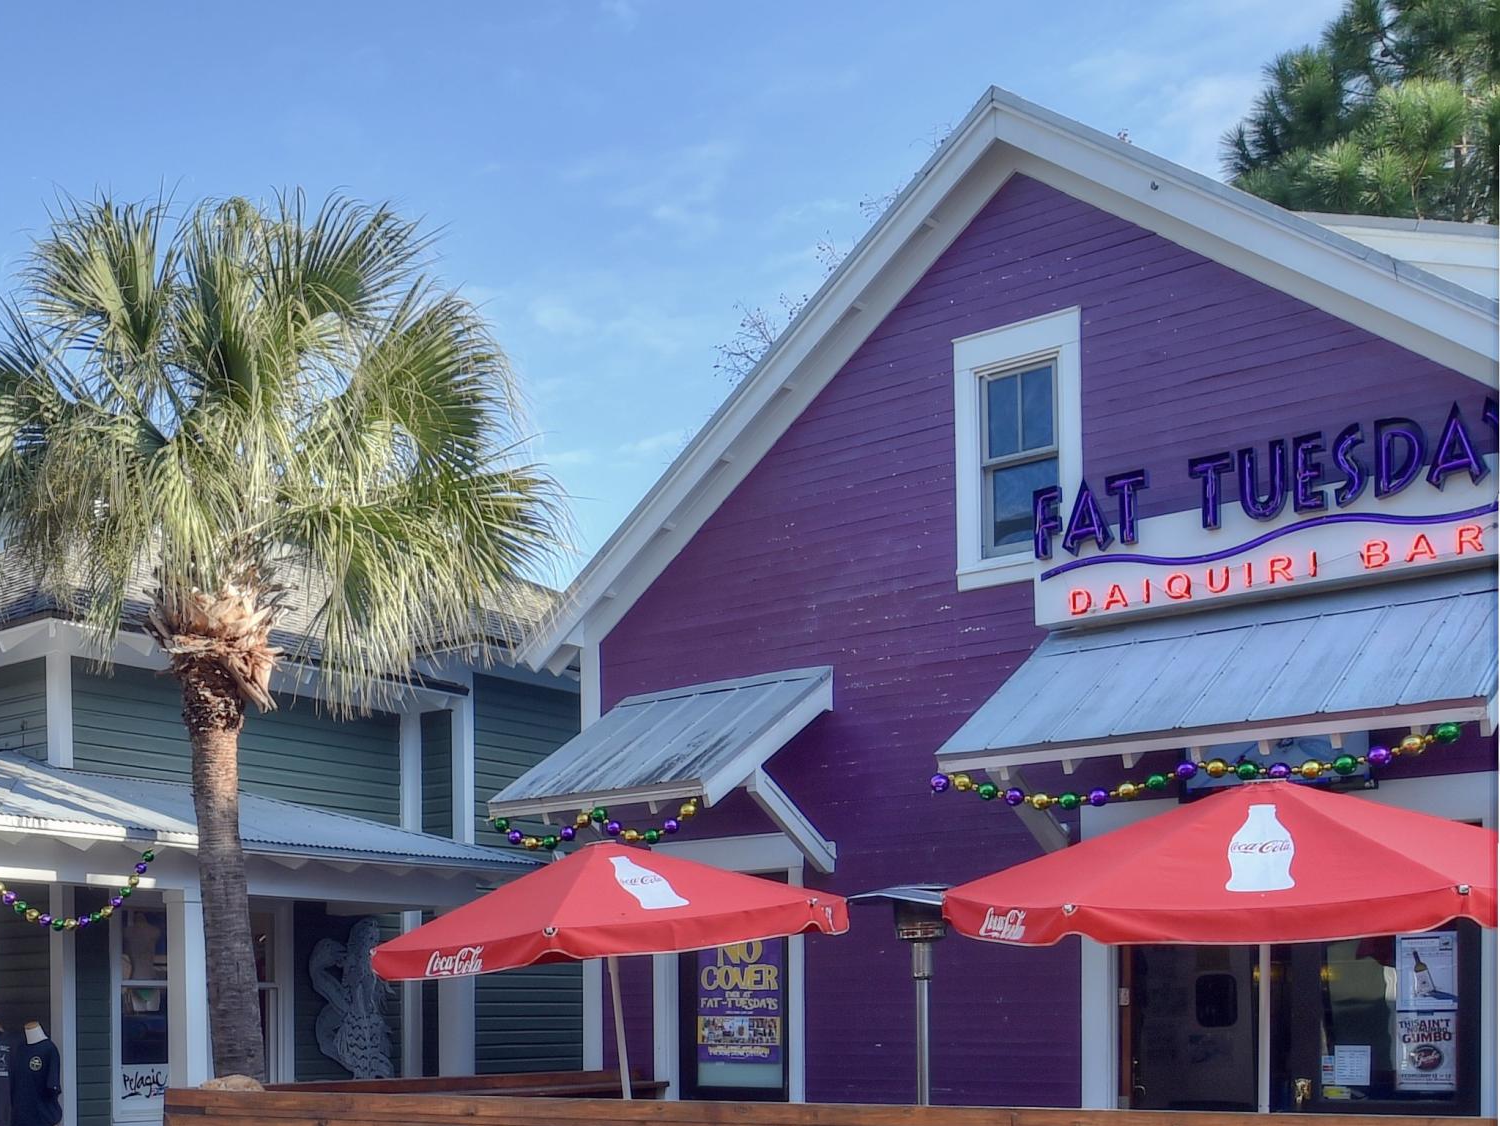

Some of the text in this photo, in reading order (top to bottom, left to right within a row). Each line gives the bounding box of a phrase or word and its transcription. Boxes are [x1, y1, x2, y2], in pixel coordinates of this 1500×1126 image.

[1033, 467, 1149, 560] FAT
[1068, 522, 1484, 616] DAIQUIRI BAR
[425, 945, 484, 977] Coca-Cola
[717, 941, 762, 967] NO
[701, 964, 778, 991] COVER
[1402, 1031, 1452, 1044] GUMBO
[121, 1067, 170, 1099] Pelagic
